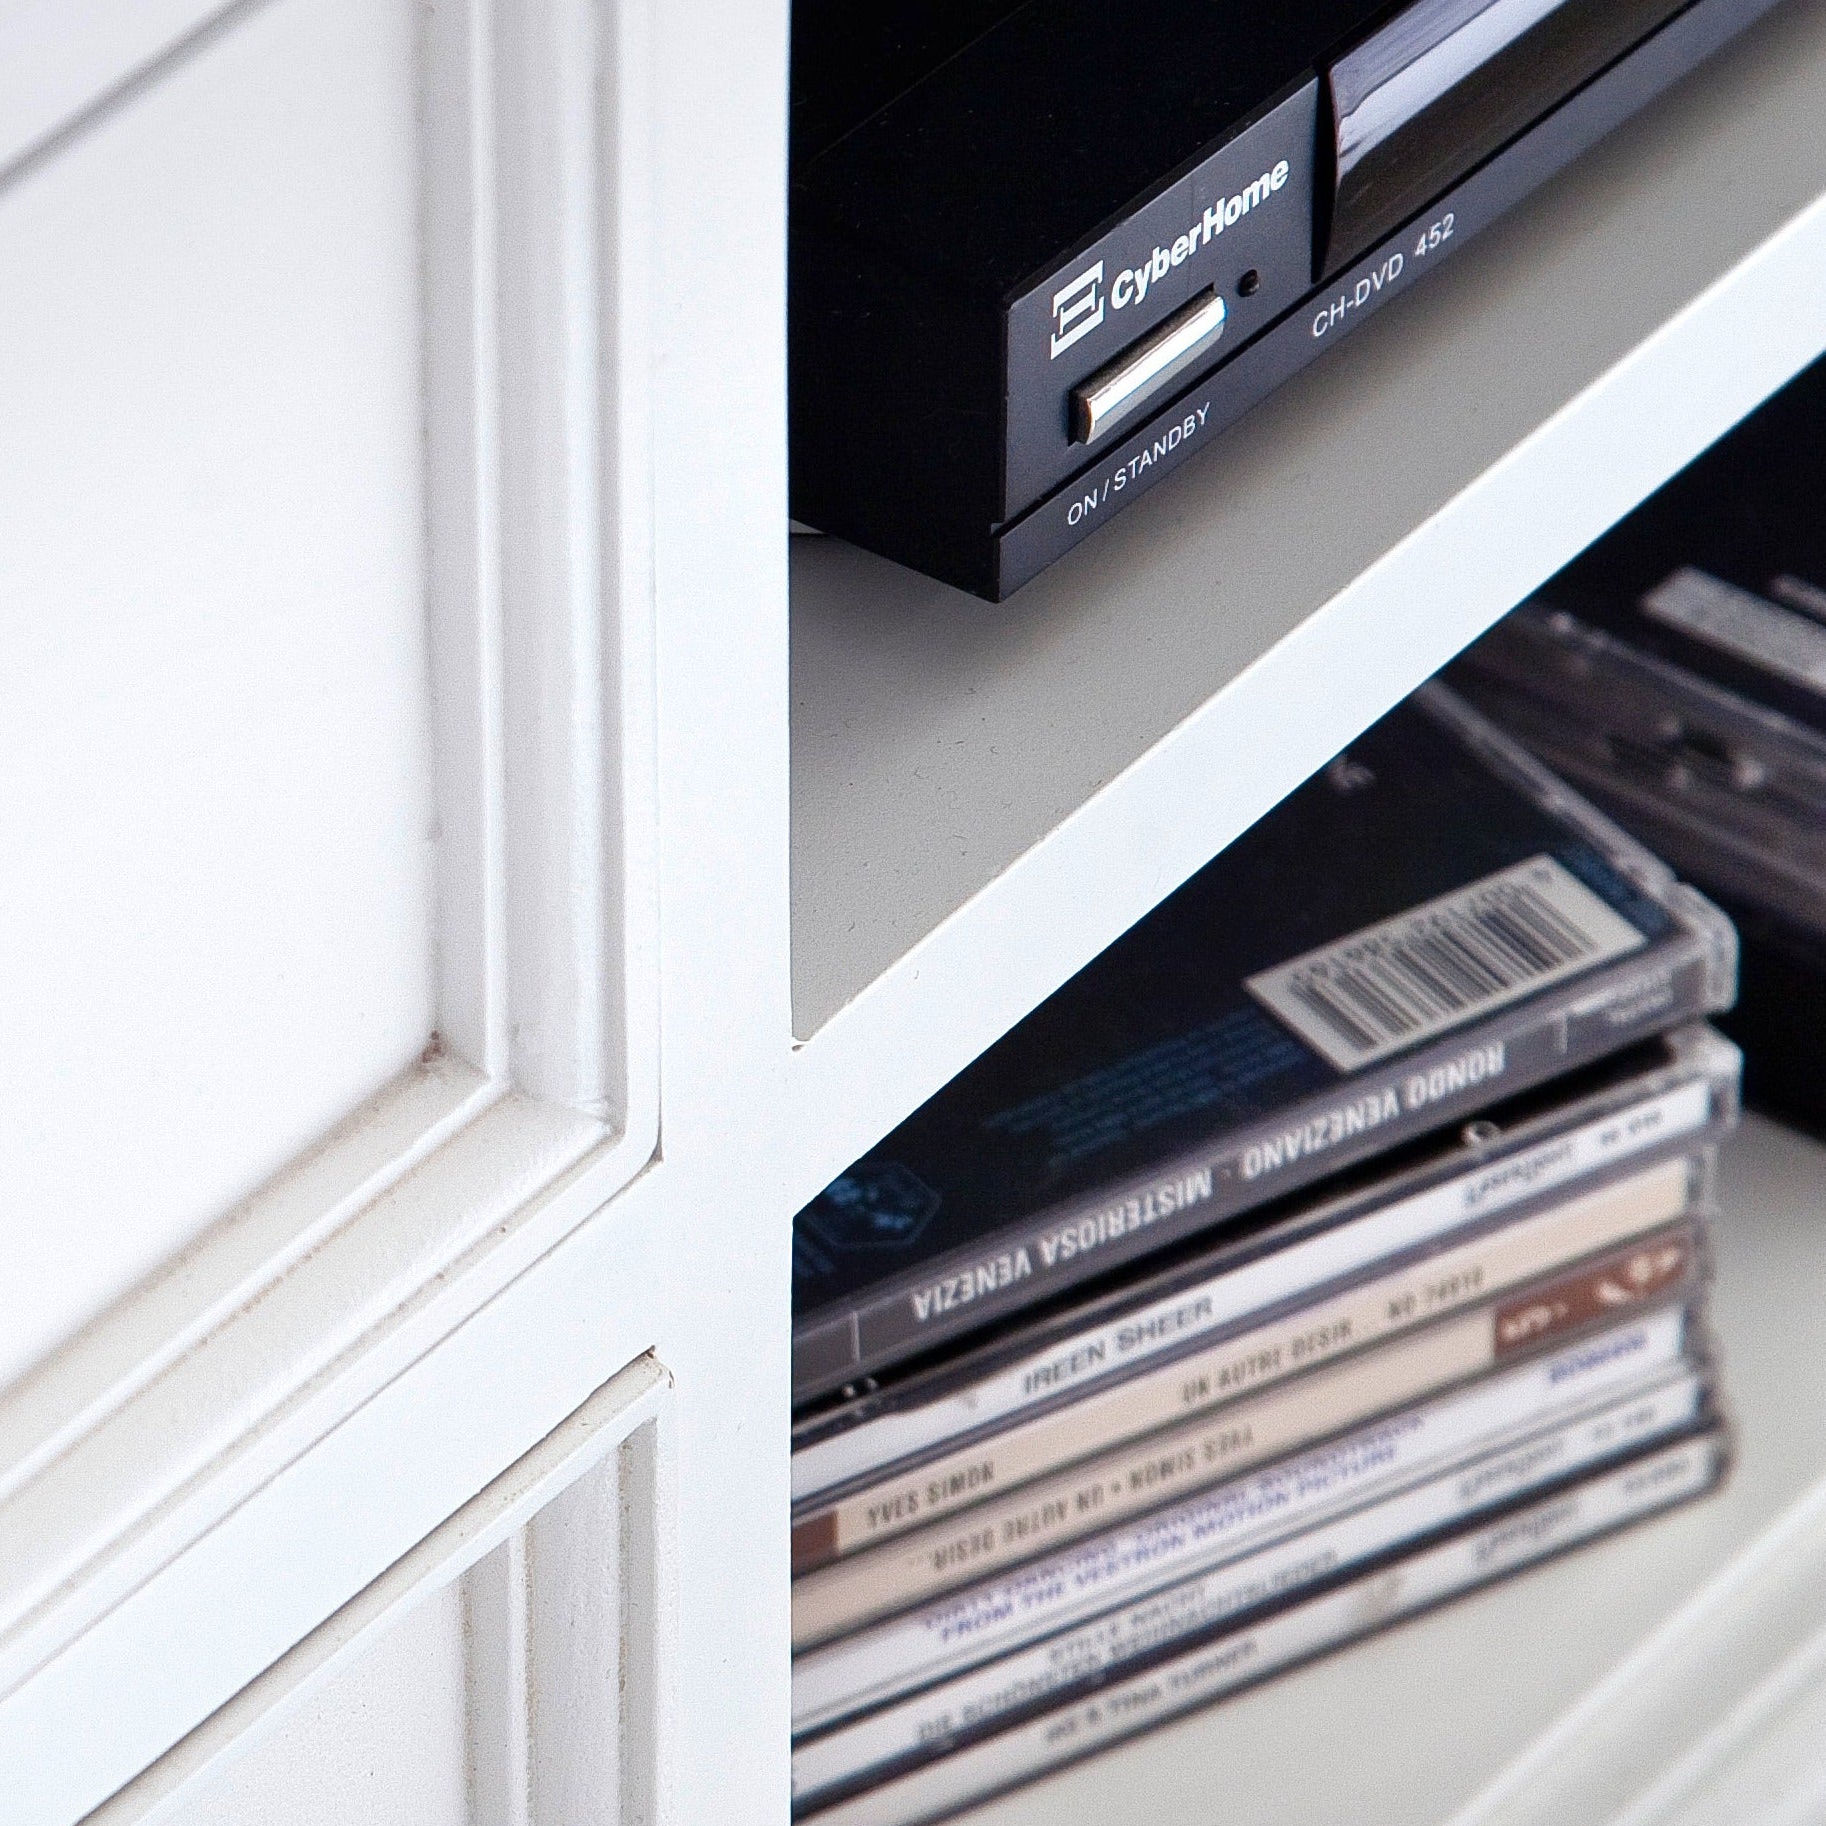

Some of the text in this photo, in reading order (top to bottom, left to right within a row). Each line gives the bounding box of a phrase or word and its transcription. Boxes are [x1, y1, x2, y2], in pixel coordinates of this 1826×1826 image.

[1111, 160, 1289, 310] CyberHome
[1312, 212, 1455, 338] CH-DVD 452
[1405, 1041, 1506, 1110] RONDO
[1240, 1087, 1400, 1181] VENEZIANO
[1039, 1167, 1213, 1267] MISTERIOSA
[912, 1248, 1033, 1322] VENEZIA
[1023, 1297, 1213, 1396] IREEN SHEER
[1218, 1348, 1282, 1387] AUTRE
[1129, 1446, 1196, 1489] SIMON
[1201, 1423, 1254, 1462] YVES
[868, 1459, 995, 1529] YVES SIMON
[1003, 1499, 1069, 1543] AUTRE
[1077, 1483, 1105, 1512] UN
[940, 1443, 1396, 1643] FROM THE VESTRON MOTION PICTURE
